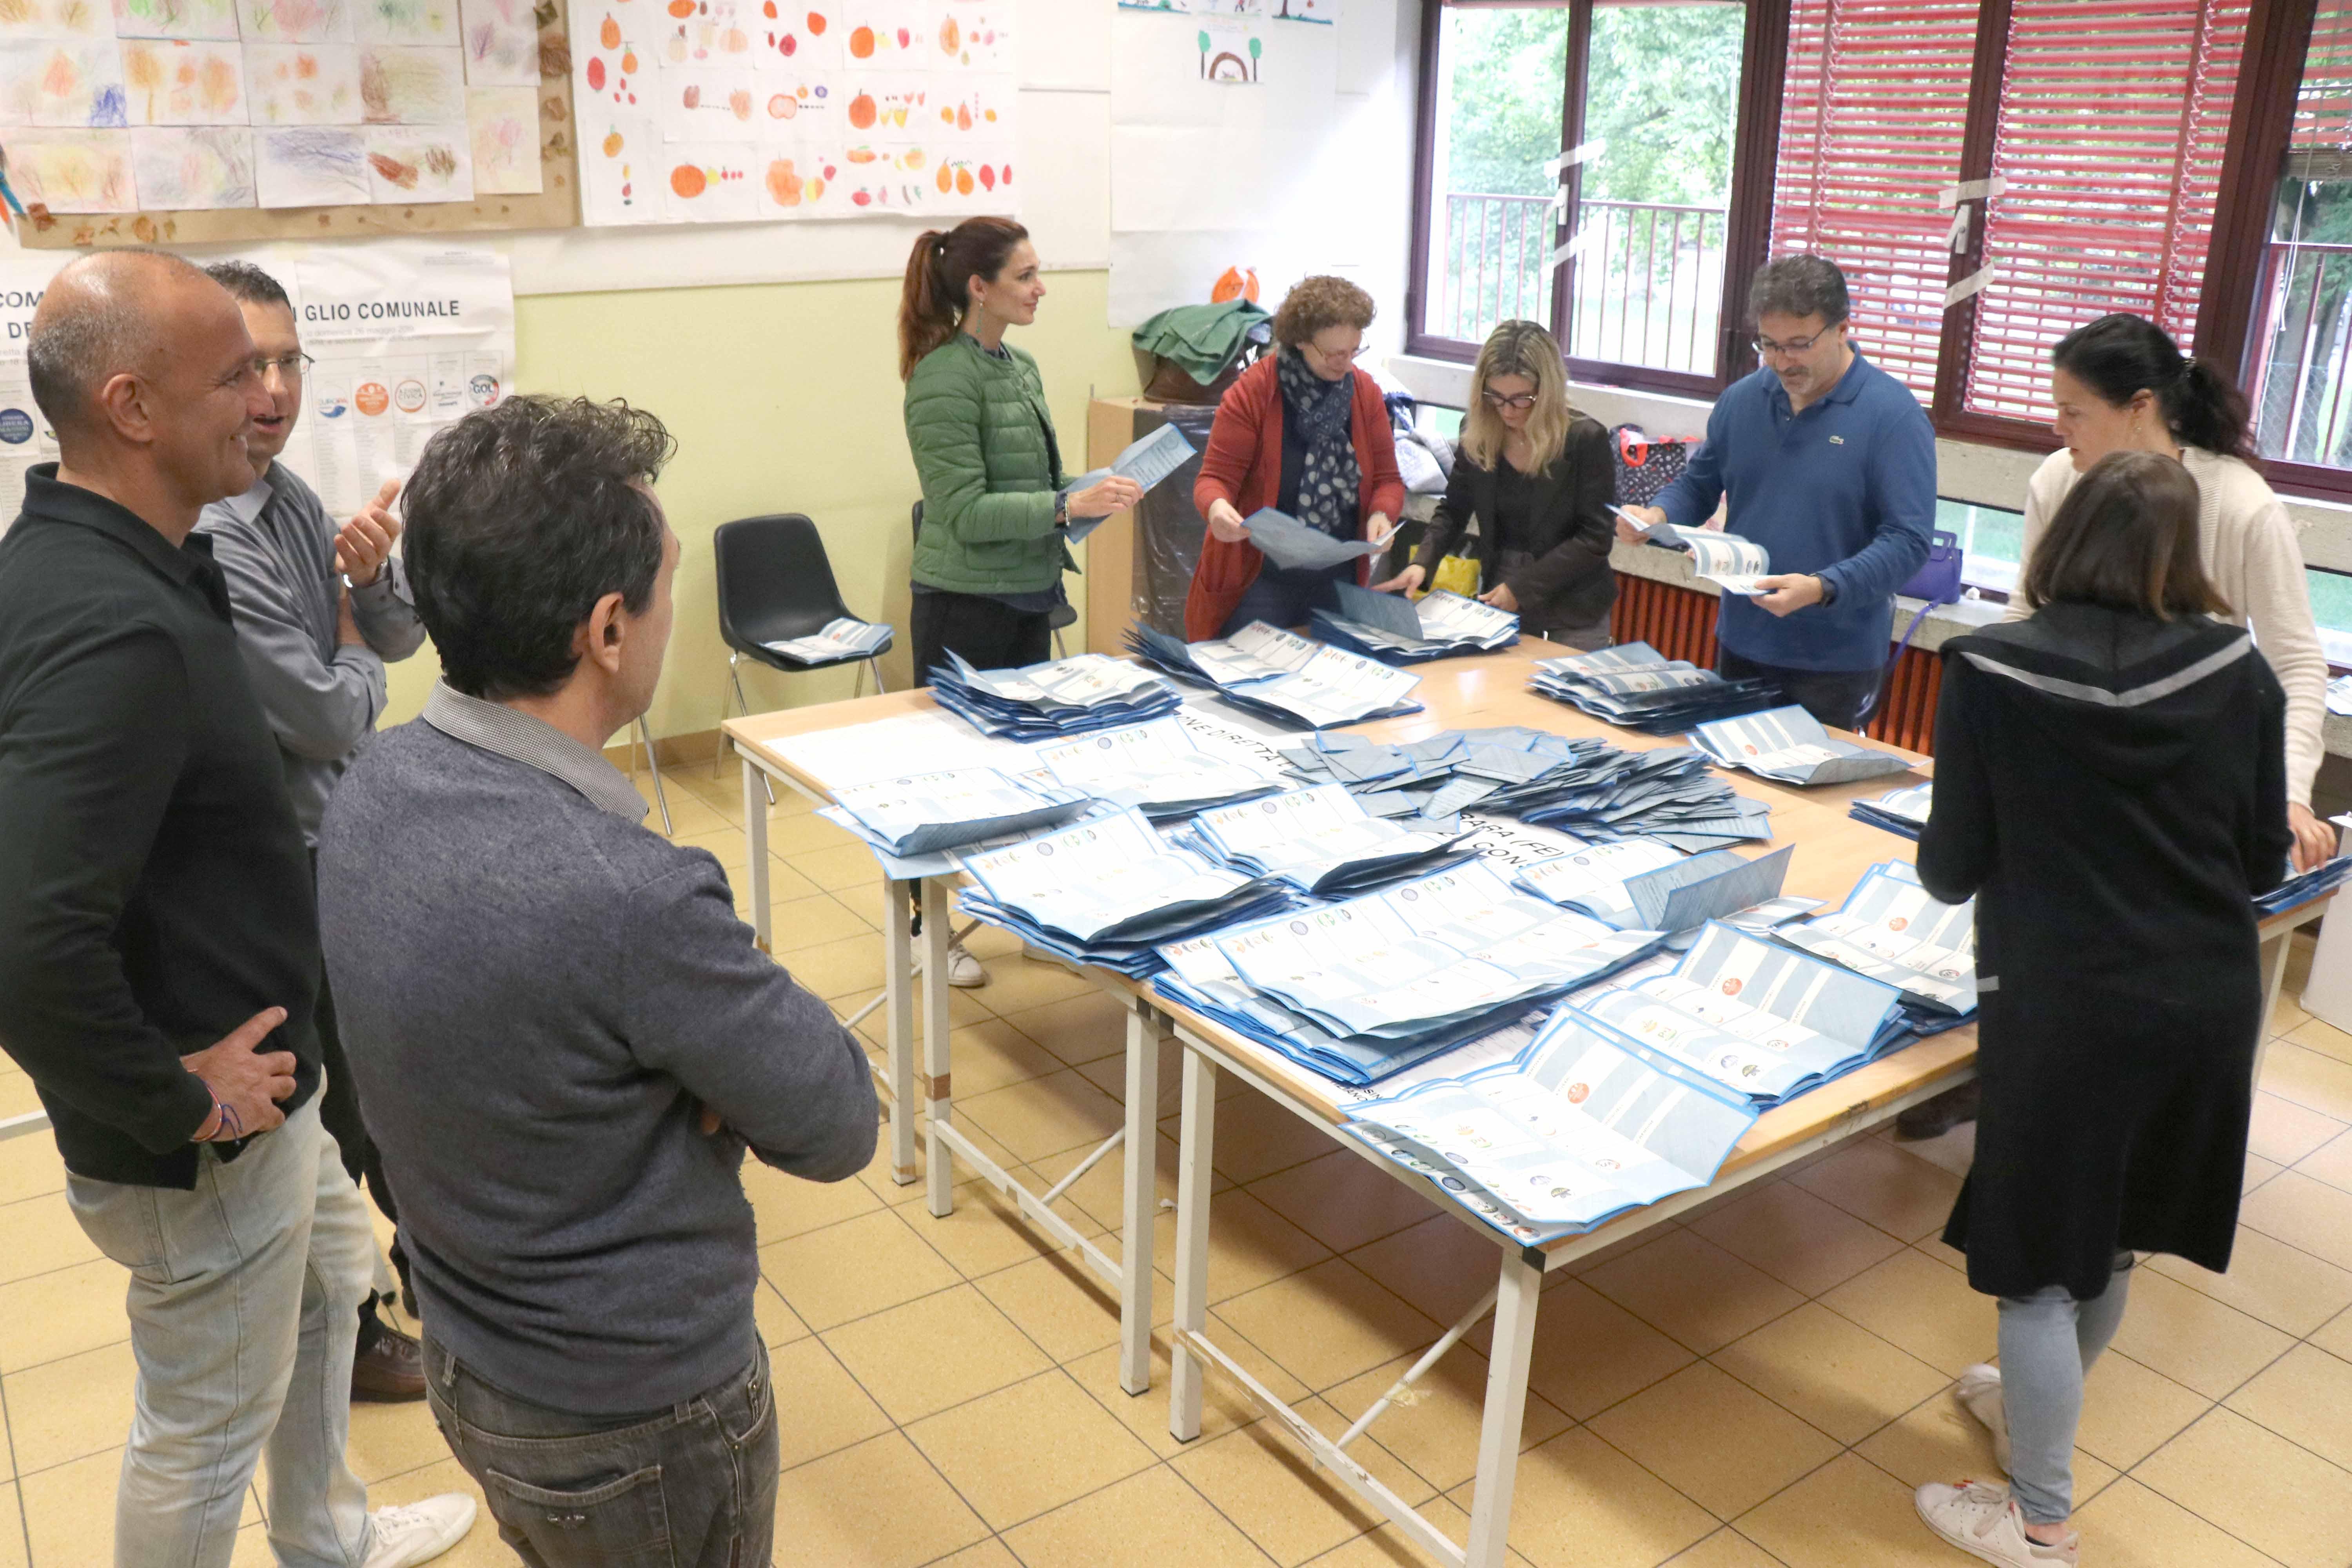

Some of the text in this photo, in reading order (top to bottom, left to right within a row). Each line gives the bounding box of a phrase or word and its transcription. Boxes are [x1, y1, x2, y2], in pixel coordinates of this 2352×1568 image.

[0, 291, 44, 308] OM
[305, 304, 350, 321] GLIO
[357, 300, 460, 319] COMUNALE
[473, 383, 493, 394] GOL
[1206, 730, 1280, 762] DIRETTA
[1472, 842, 1528, 868] CON
